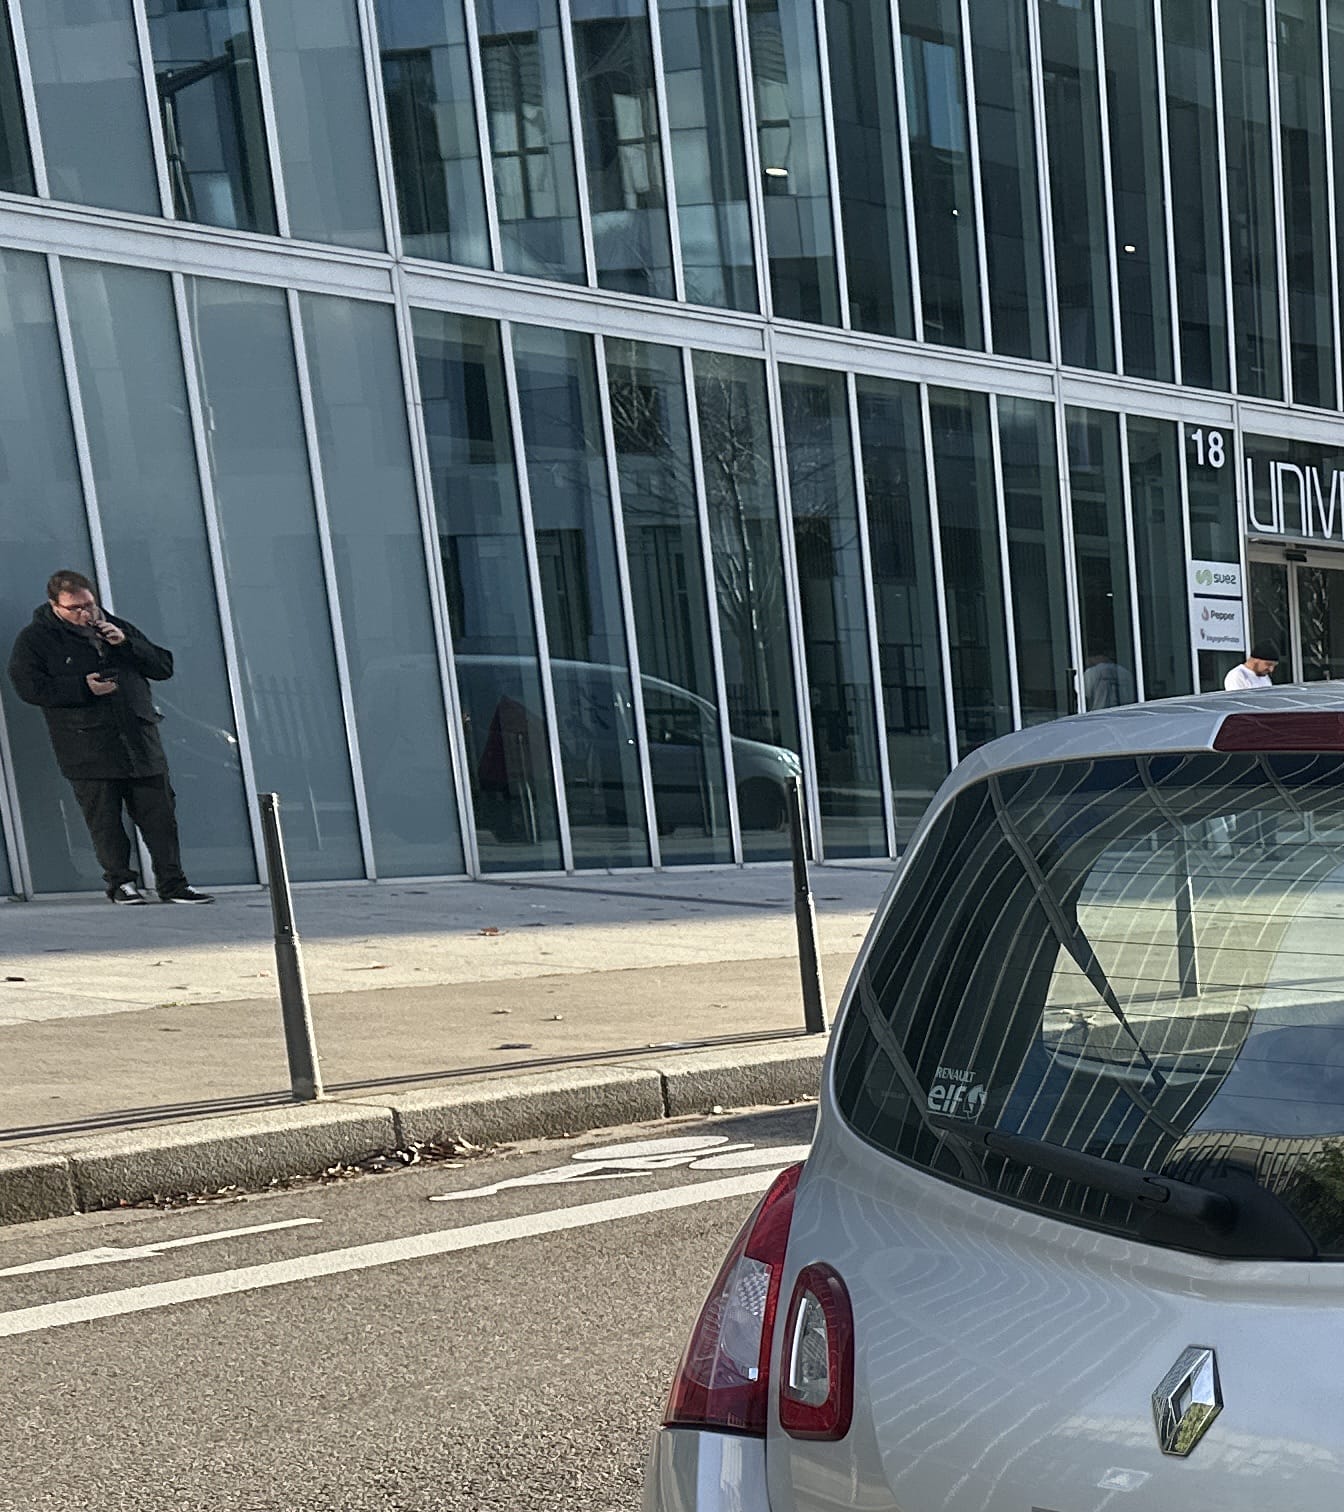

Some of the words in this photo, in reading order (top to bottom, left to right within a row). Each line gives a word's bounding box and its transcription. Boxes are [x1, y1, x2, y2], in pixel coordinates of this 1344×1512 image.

[1191, 427, 1226, 469] 18
[936, 1065, 977, 1083] RENAULT
[927, 1083, 968, 1114] elf
